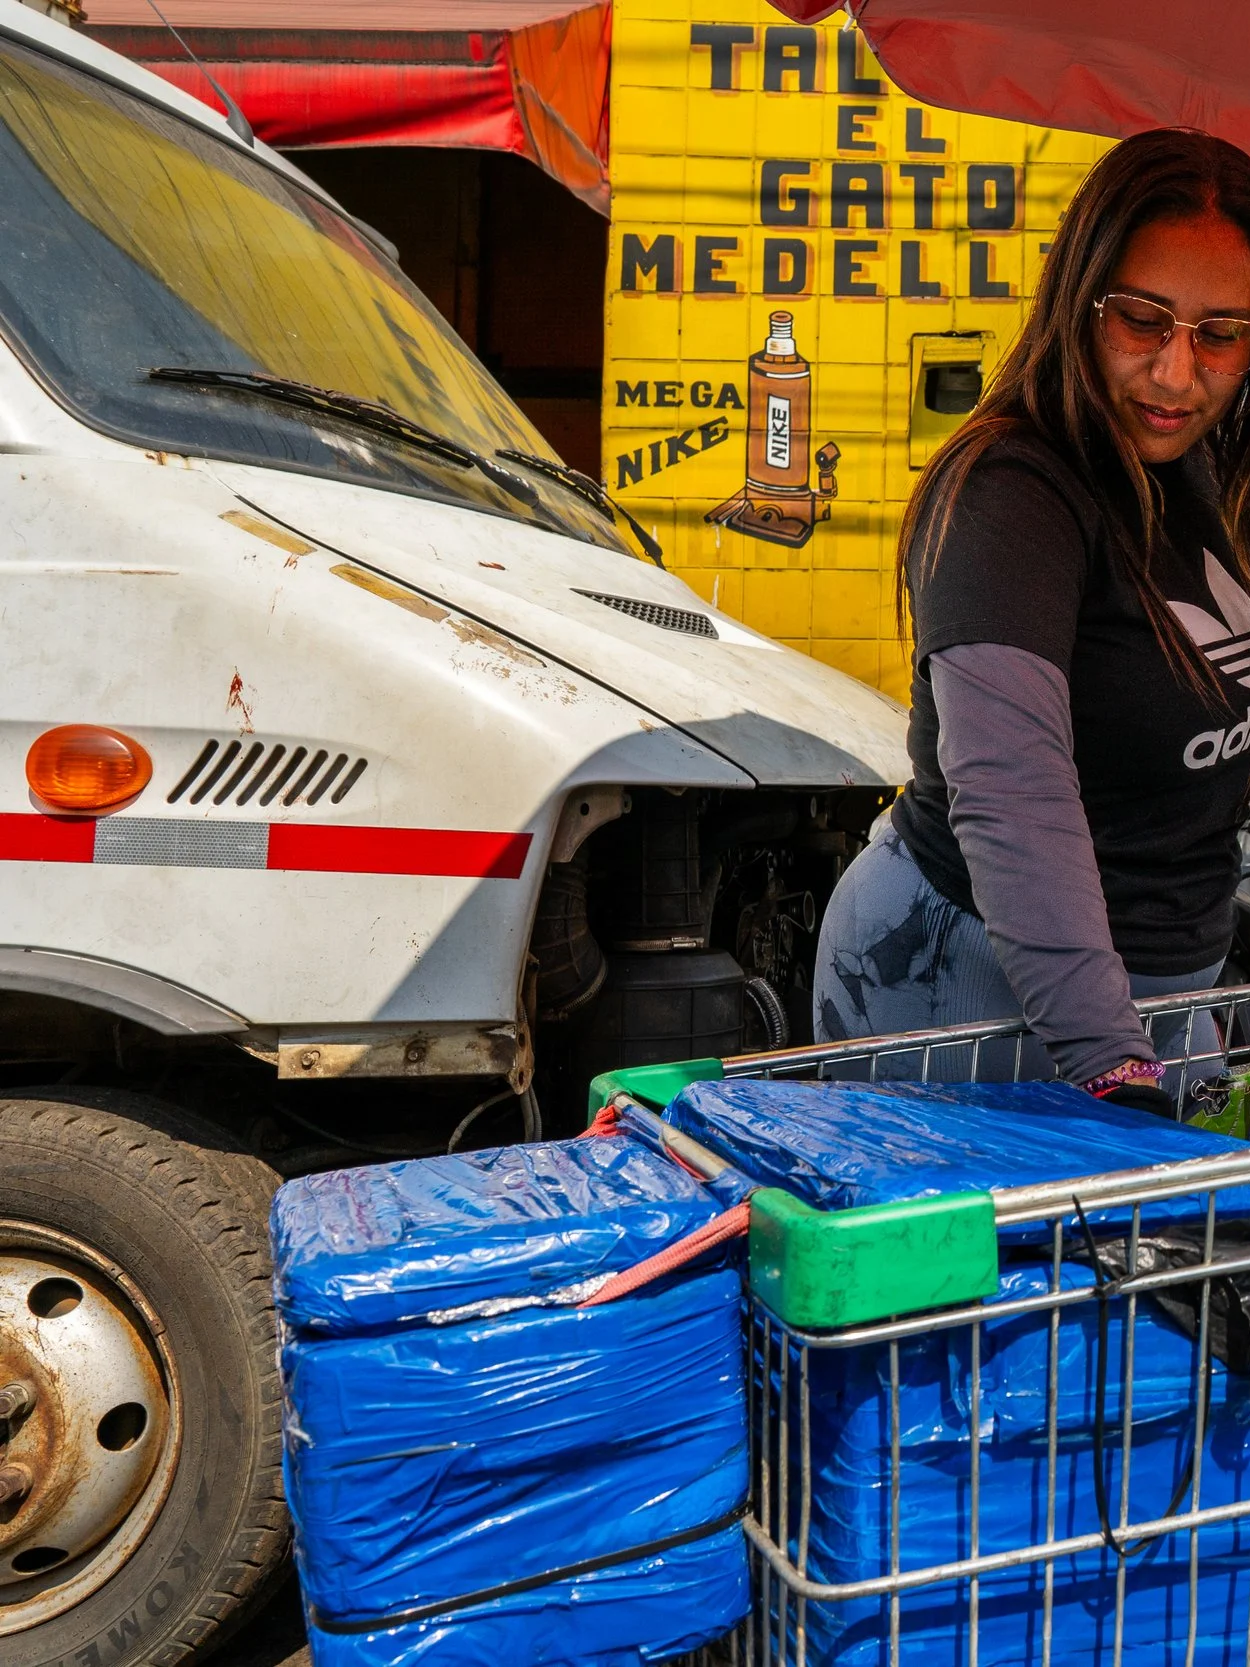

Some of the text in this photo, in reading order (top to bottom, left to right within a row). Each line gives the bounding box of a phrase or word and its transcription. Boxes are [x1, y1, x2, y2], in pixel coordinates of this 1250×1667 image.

[690, 24, 886, 97] TAL
[837, 105, 951, 158] EL
[760, 159, 1023, 235] GATO
[620, 233, 1053, 304] MEDELL
[615, 379, 746, 410] MEGA
[616, 415, 730, 490] NIKE
[770, 406, 787, 461] NIKE
[55, 1540, 202, 1667] KOME
